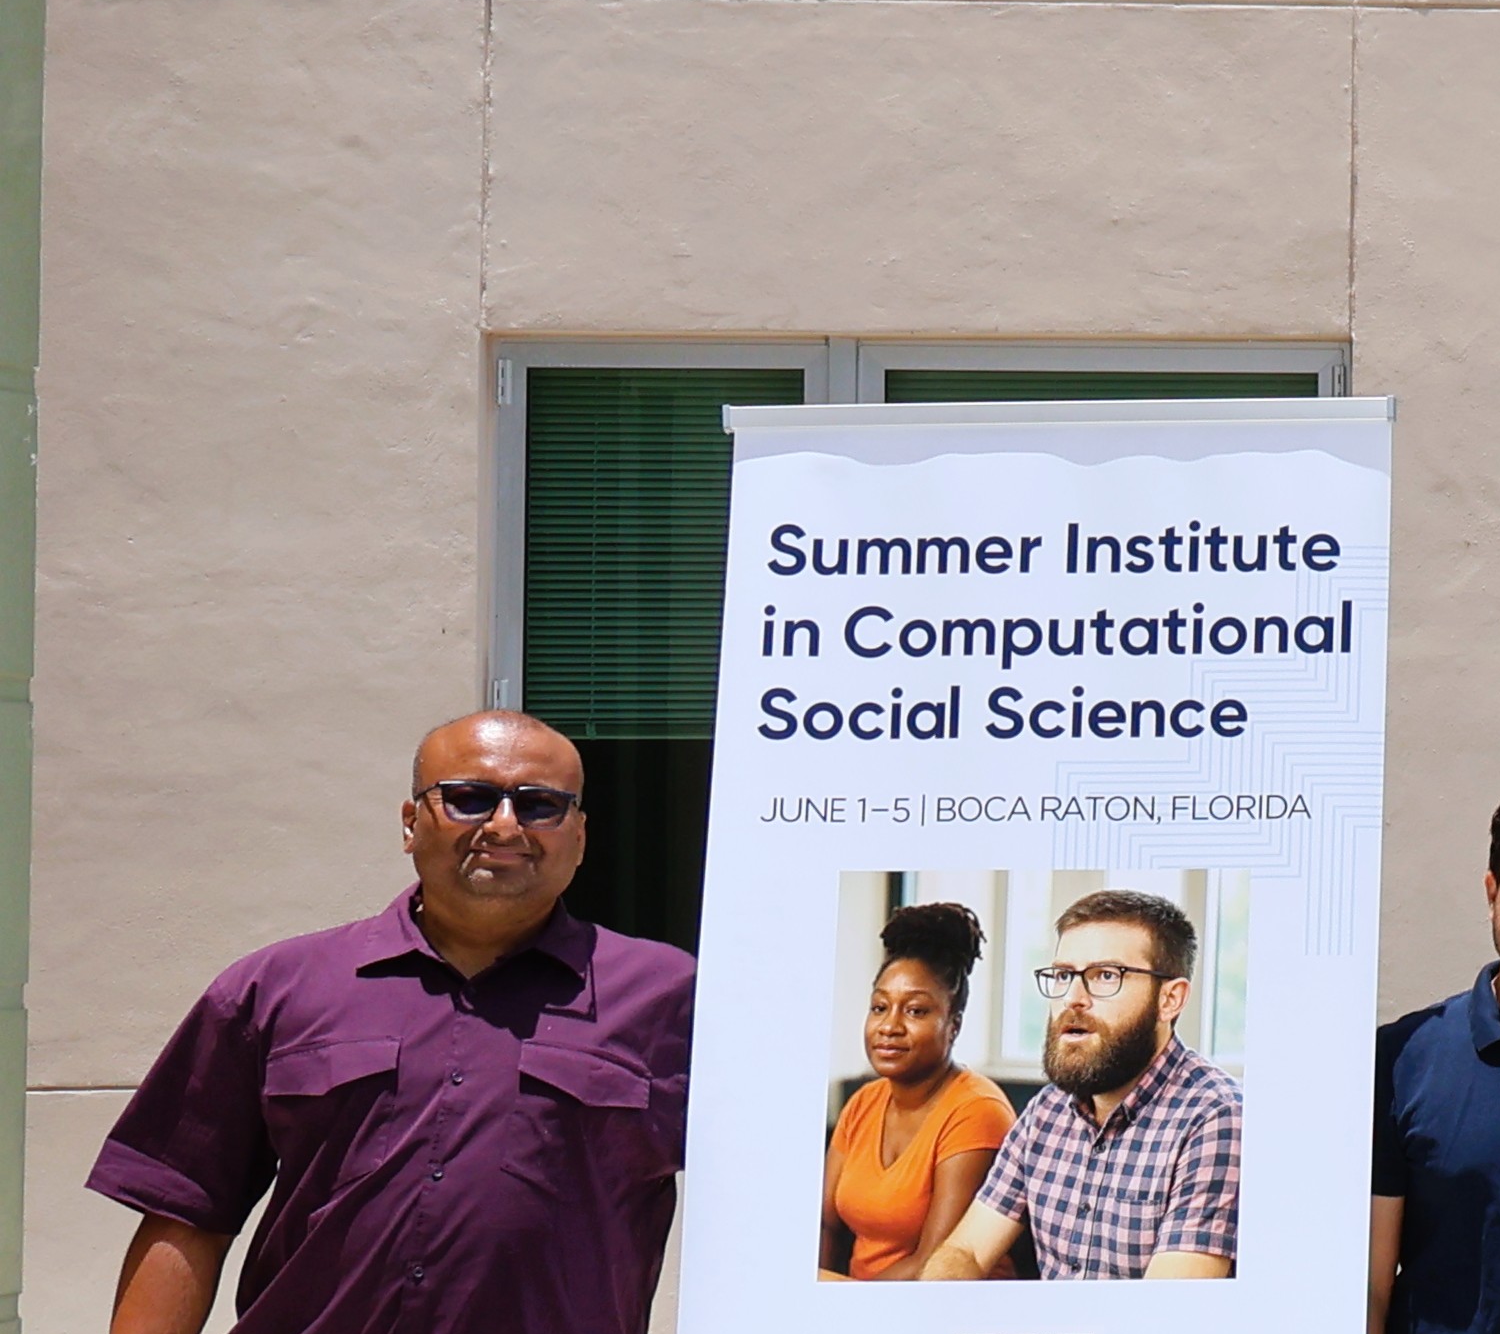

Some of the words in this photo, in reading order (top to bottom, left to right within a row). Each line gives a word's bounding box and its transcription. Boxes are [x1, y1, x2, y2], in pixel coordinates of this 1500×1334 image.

[767, 523, 1042, 577] Summer
[1066, 520, 1340, 574] Institute
[762, 605, 820, 658] in
[844, 600, 1352, 670] Computational
[757, 686, 960, 742] Social
[986, 686, 1248, 740] Science
[760, 797, 846, 825] JUNE
[935, 796, 1031, 824] BOCA
[1041, 795, 1162, 826] RATON,
[1171, 794, 1312, 822] FLORIDA
